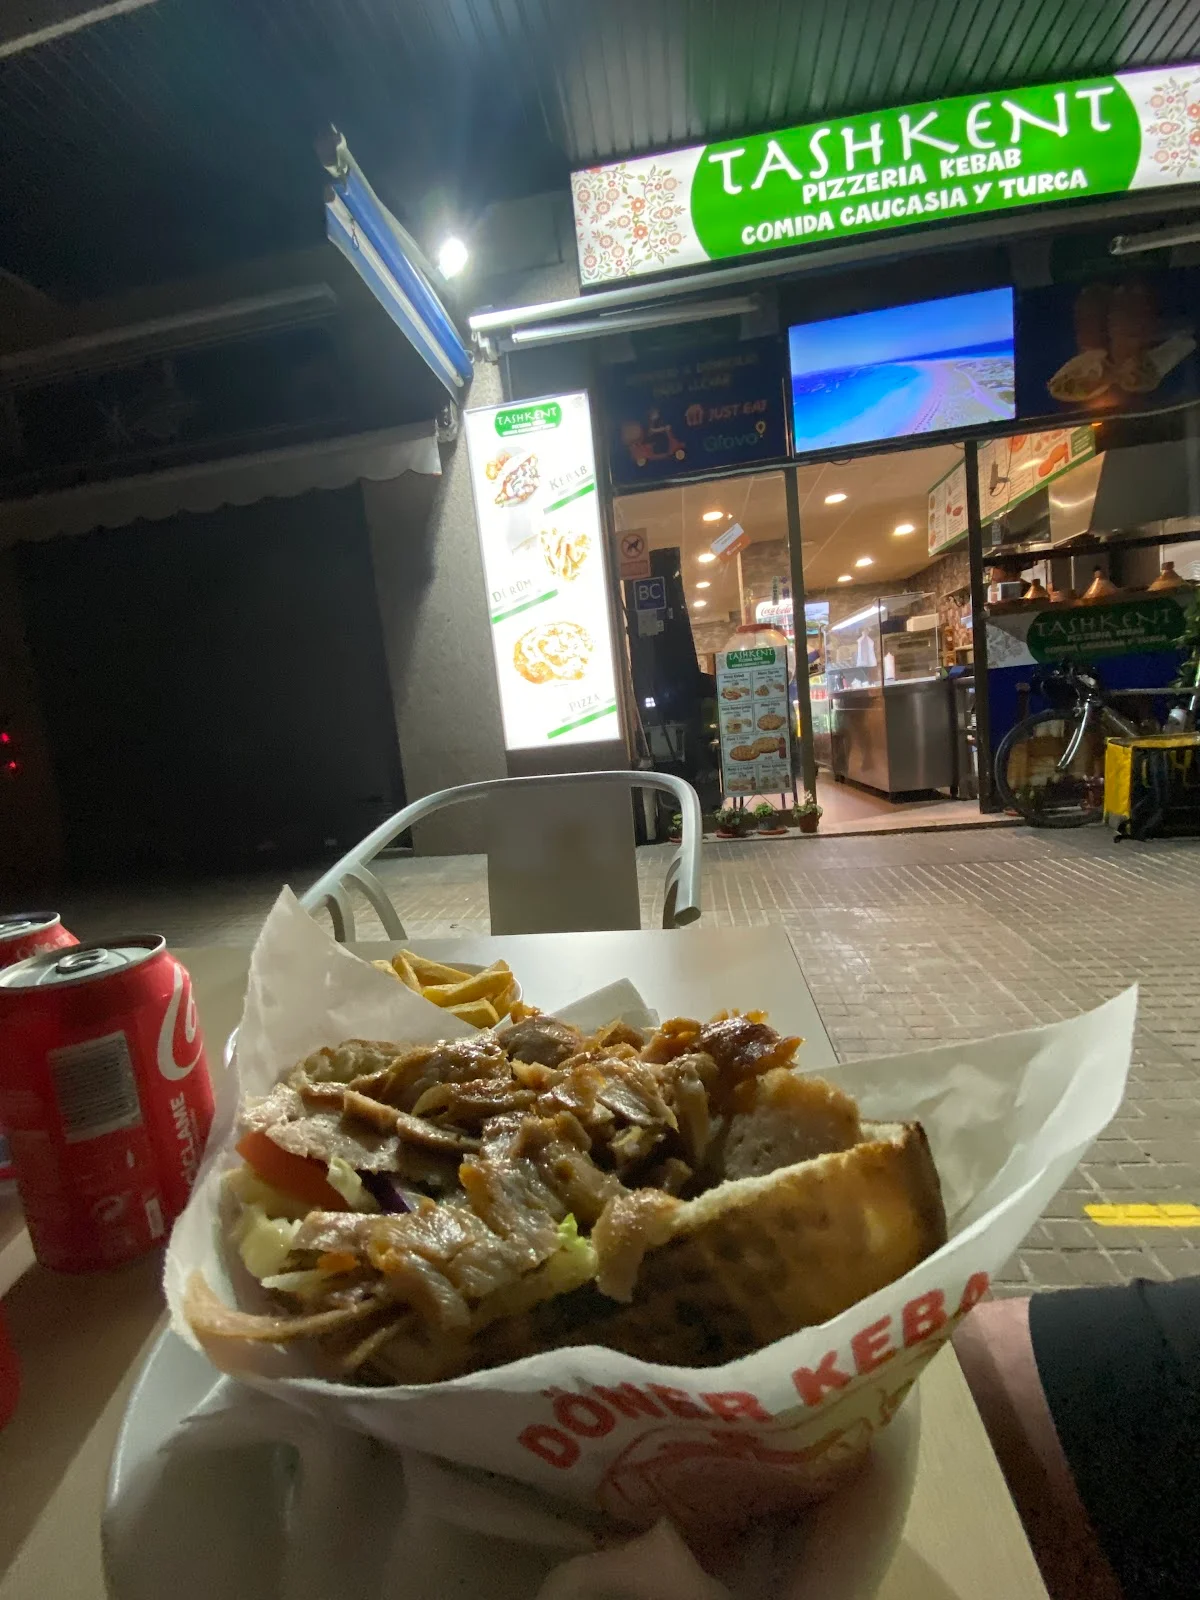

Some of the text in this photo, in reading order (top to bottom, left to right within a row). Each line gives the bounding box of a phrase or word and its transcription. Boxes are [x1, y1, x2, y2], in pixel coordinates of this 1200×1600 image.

[708, 86, 1115, 196] TASHKENT
[802, 147, 1023, 205] PIZZERIA KEBAB
[741, 168, 1089, 246] COMIDA CAUCASIA Y TURCA
[497, 407, 557, 426] TASHKENT
[708, 404, 740, 422] JUST
[638, 583, 661, 600] BC
[1034, 608, 1172, 637] TASHKENT
